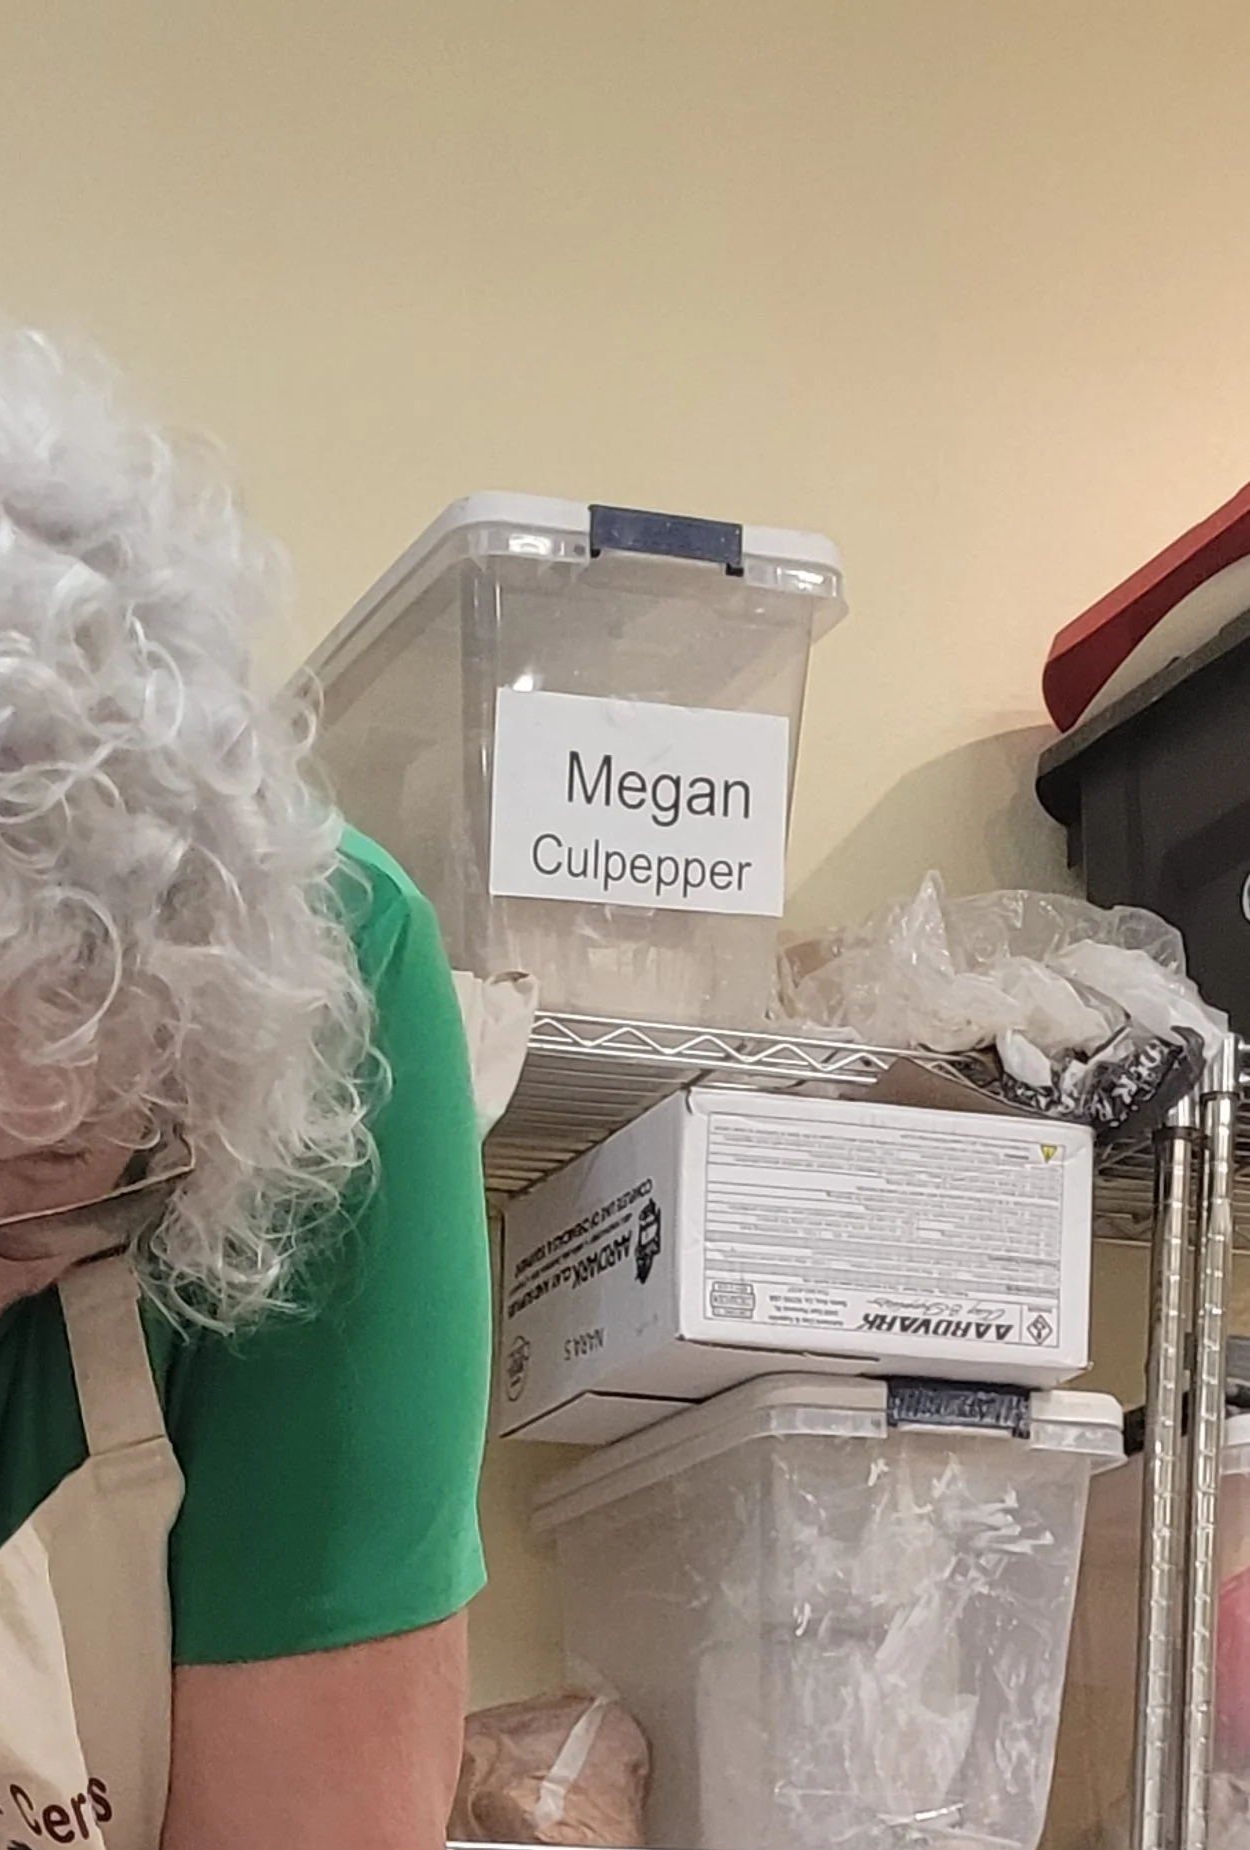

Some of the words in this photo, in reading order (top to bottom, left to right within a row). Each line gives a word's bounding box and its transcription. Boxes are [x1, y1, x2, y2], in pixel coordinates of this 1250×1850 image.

[567, 750, 751, 827] Megan
[533, 833, 753, 898] Culpepper
[856, 1312, 1014, 1341] AARDVARK
